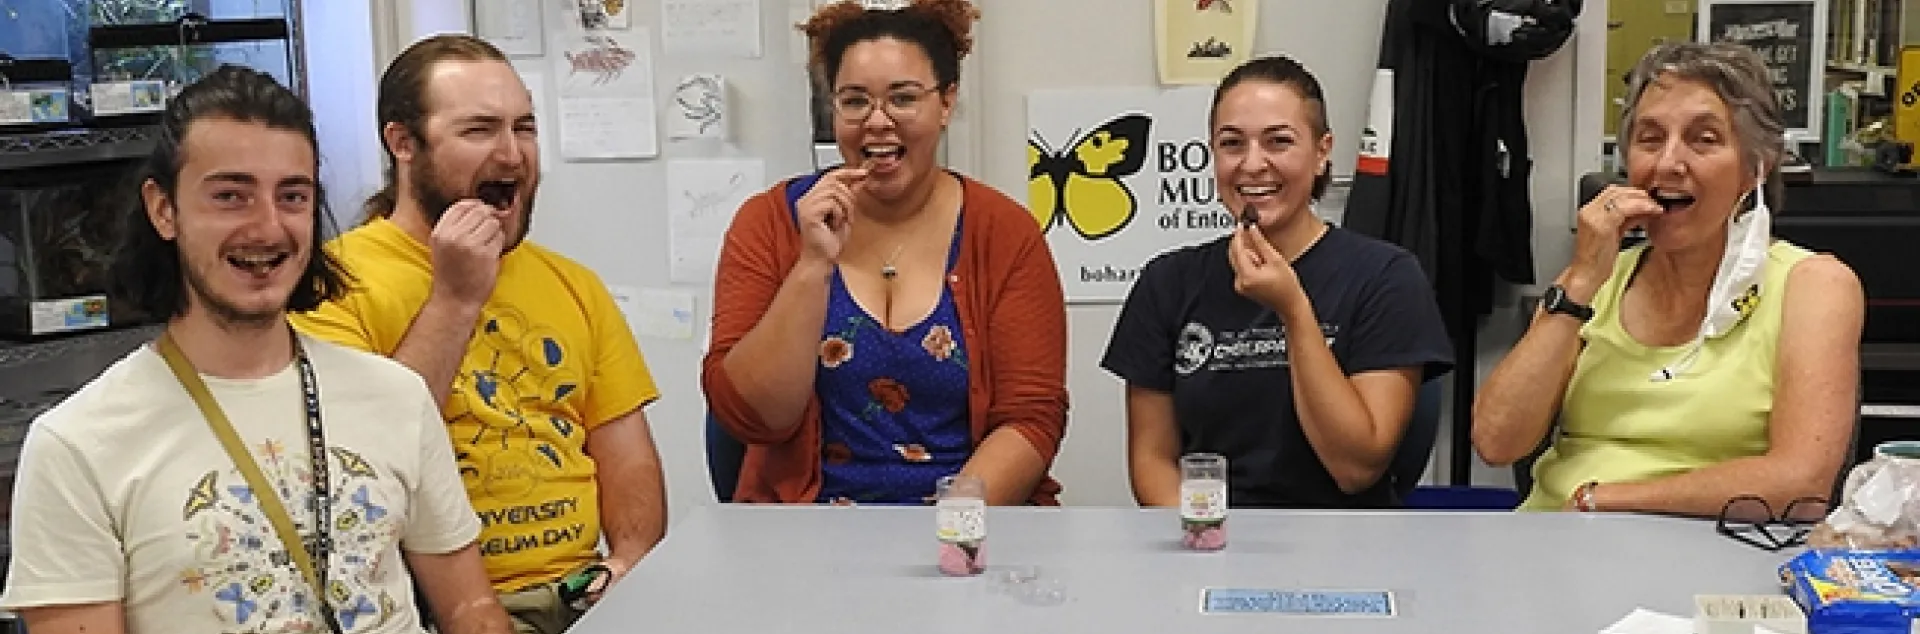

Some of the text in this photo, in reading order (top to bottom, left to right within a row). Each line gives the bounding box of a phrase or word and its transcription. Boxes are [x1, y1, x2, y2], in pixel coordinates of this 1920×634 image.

[1157, 142, 1210, 173] BO
[1157, 178, 1216, 205] MU
[1157, 208, 1236, 229] of Ento
[1080, 267, 1139, 282] bohar
[543, 523, 586, 547] DAY
